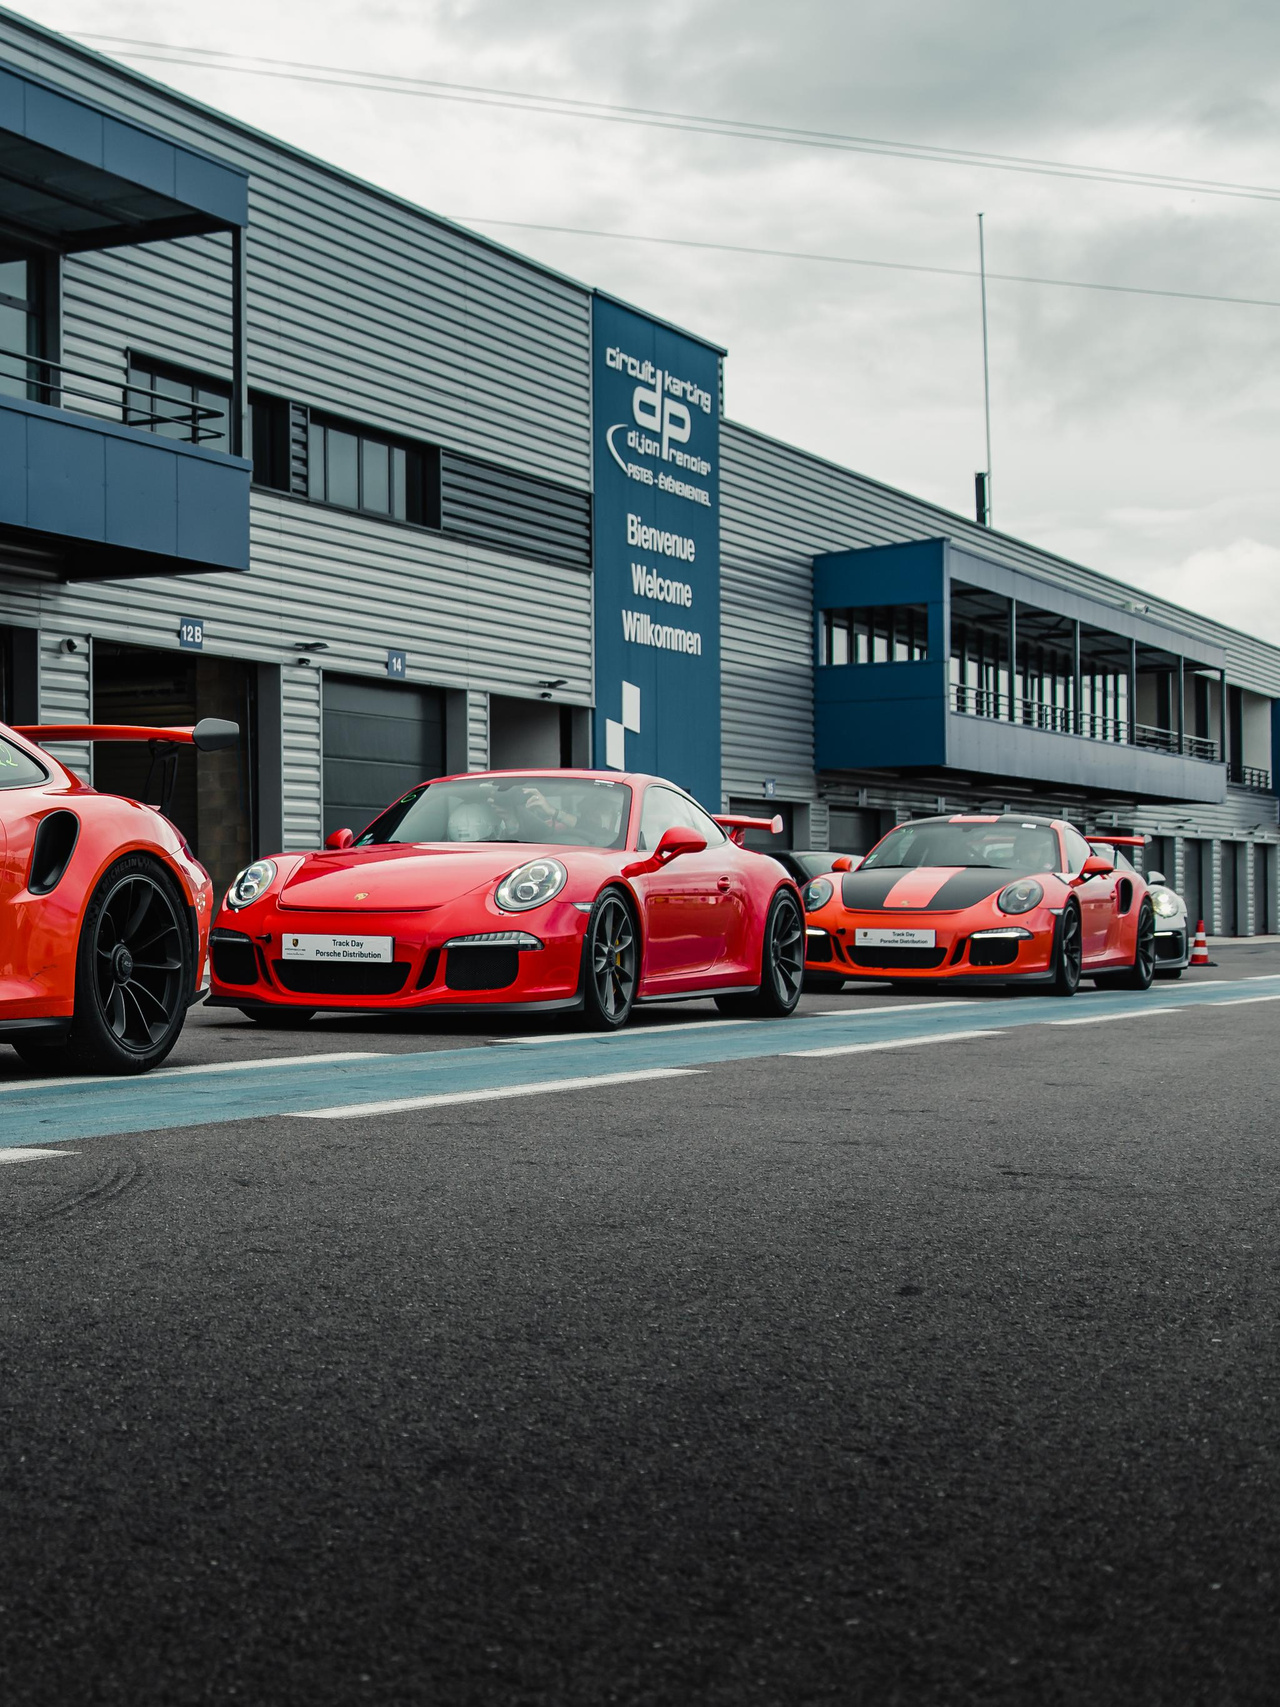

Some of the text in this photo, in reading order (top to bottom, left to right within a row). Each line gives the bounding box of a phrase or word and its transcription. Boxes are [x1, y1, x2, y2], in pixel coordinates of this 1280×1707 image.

[606, 347, 712, 414] circuit karting
[627, 429, 660, 455] dijon
[627, 462, 654, 486] PISTES
[626, 512, 696, 563] Bienvenue
[631, 562, 693, 608] Welcome
[182, 624, 202, 643] 12B
[621, 609, 702, 656] Willkommen
[392, 656, 402, 672] 14
[102, 857, 138, 892] MICHELIN
[315, 949, 341, 958] Porsche
[342, 950, 382, 959] Distribution
[332, 939, 364, 949] Track Day
